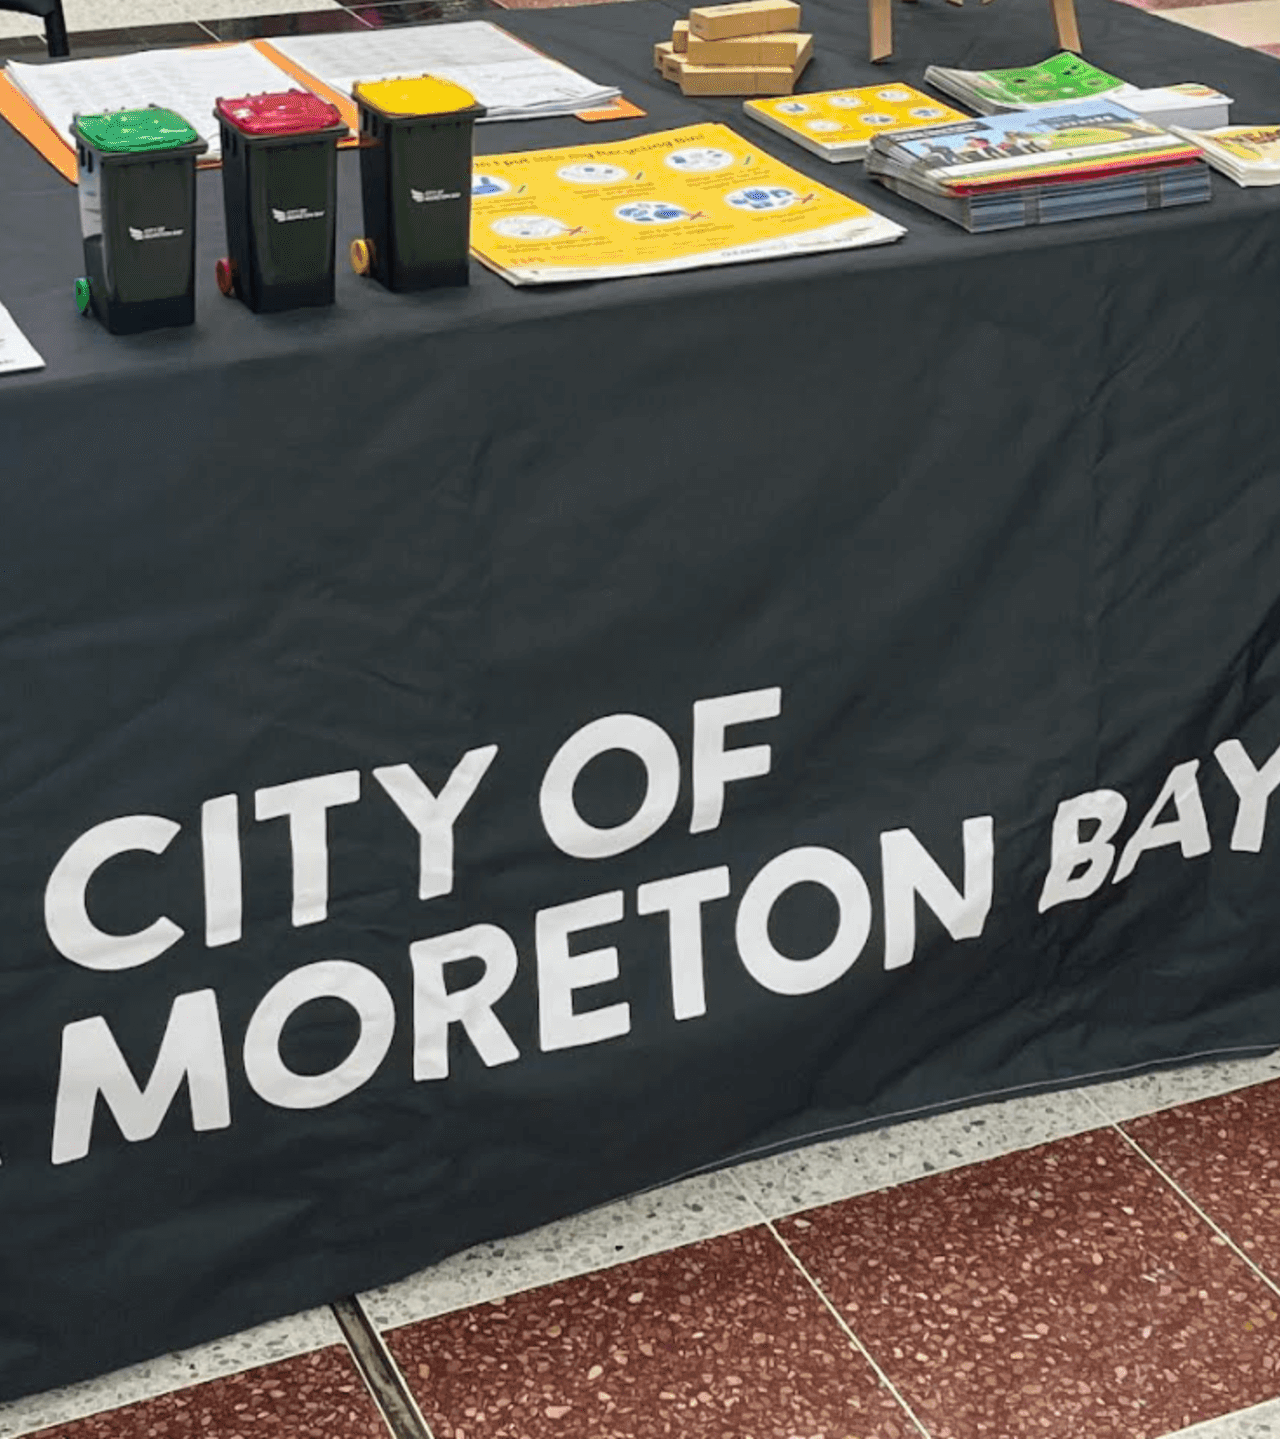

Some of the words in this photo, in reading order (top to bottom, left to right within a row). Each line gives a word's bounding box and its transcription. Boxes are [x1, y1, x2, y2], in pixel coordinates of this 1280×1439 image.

[43, 743, 498, 971] CITY
[537, 686, 783, 860] OF
[51, 812, 995, 1166] MORETON
